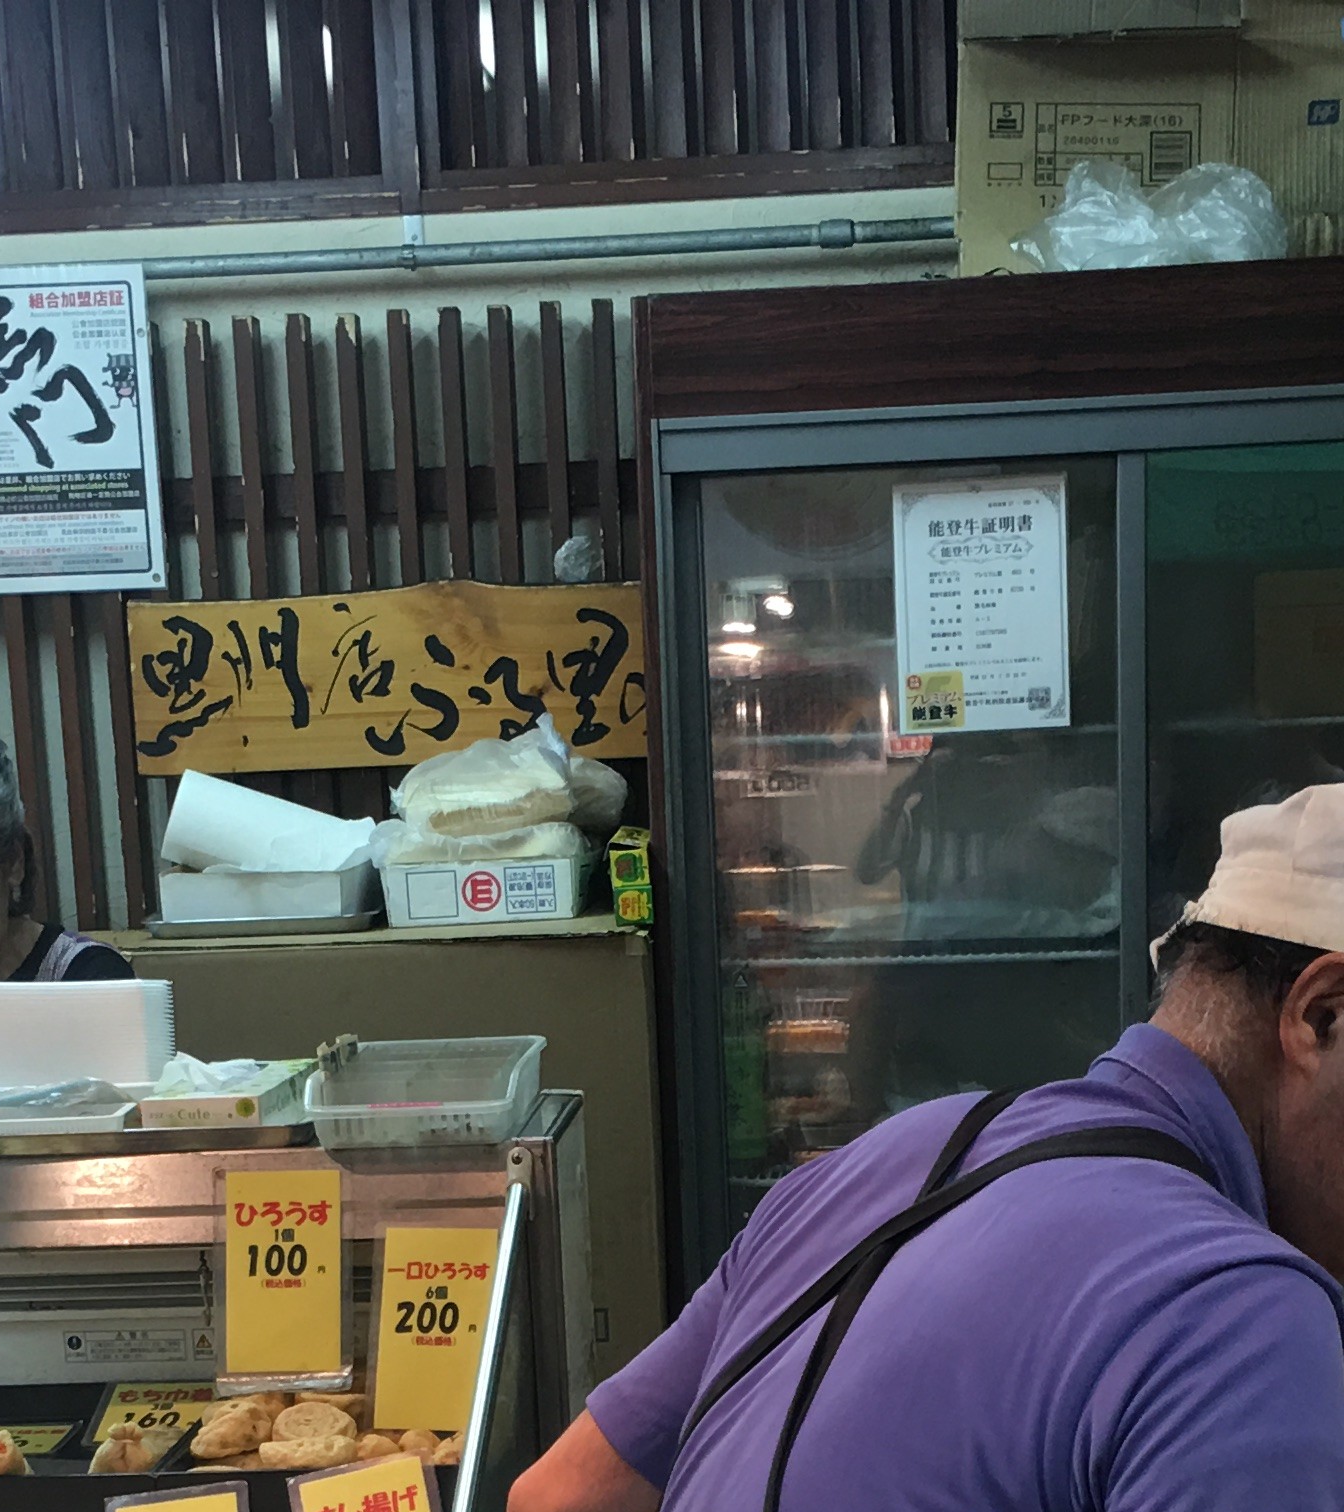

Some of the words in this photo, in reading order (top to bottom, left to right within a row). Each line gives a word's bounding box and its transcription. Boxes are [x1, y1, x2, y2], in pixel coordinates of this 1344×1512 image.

[28, 290, 125, 309] 組合加盟店証
[928, 514, 1033, 537] 能登牛証明書
[940, 543, 1023, 558] 能登牛プレミアム
[233, 1200, 333, 1228] ひろうす
[274, 1228, 296, 1243] 1個
[248, 1244, 308, 1277] 100
[387, 1261, 491, 1282] 一口ひろうす
[425, 1286, 449, 1300] 6個
[395, 1301, 460, 1334] 200
